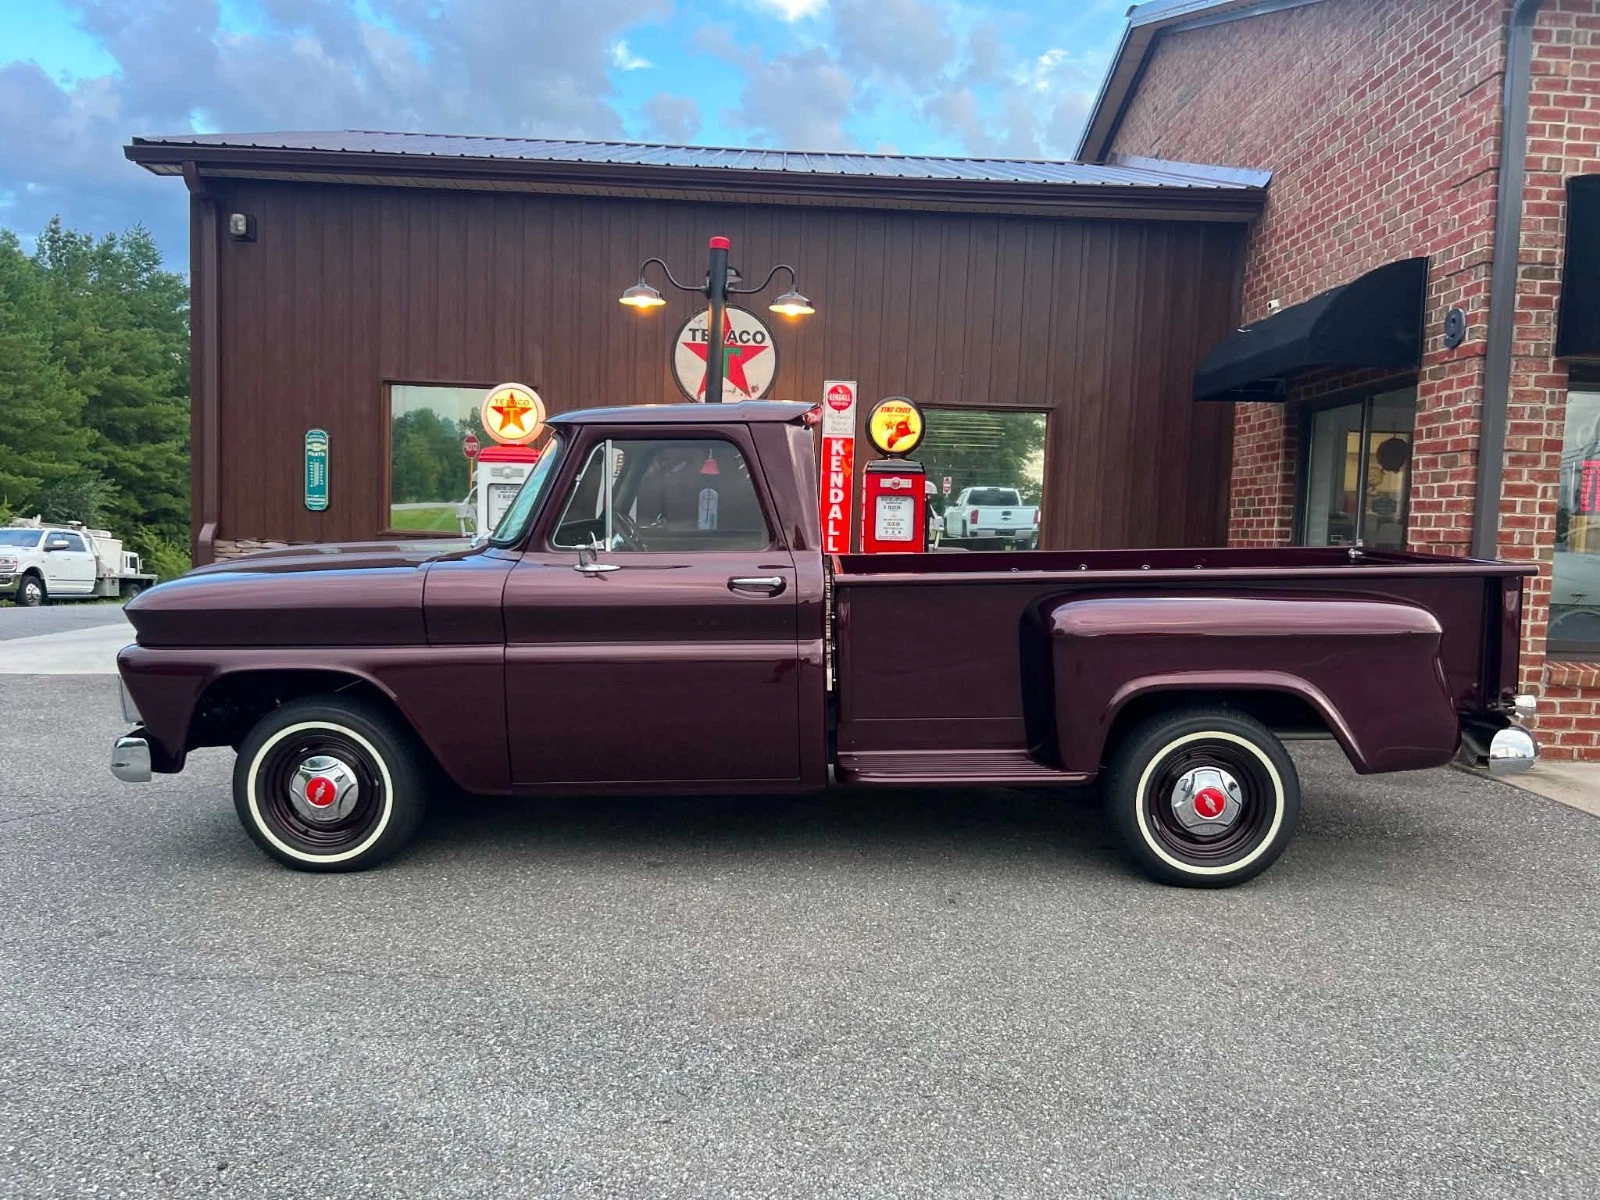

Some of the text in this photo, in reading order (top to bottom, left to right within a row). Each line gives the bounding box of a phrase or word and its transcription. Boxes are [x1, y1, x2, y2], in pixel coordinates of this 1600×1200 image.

[688, 328, 766, 345] TEACO
[494, 398, 530, 406] TEXACO
[827, 439, 845, 552] KENDALL
